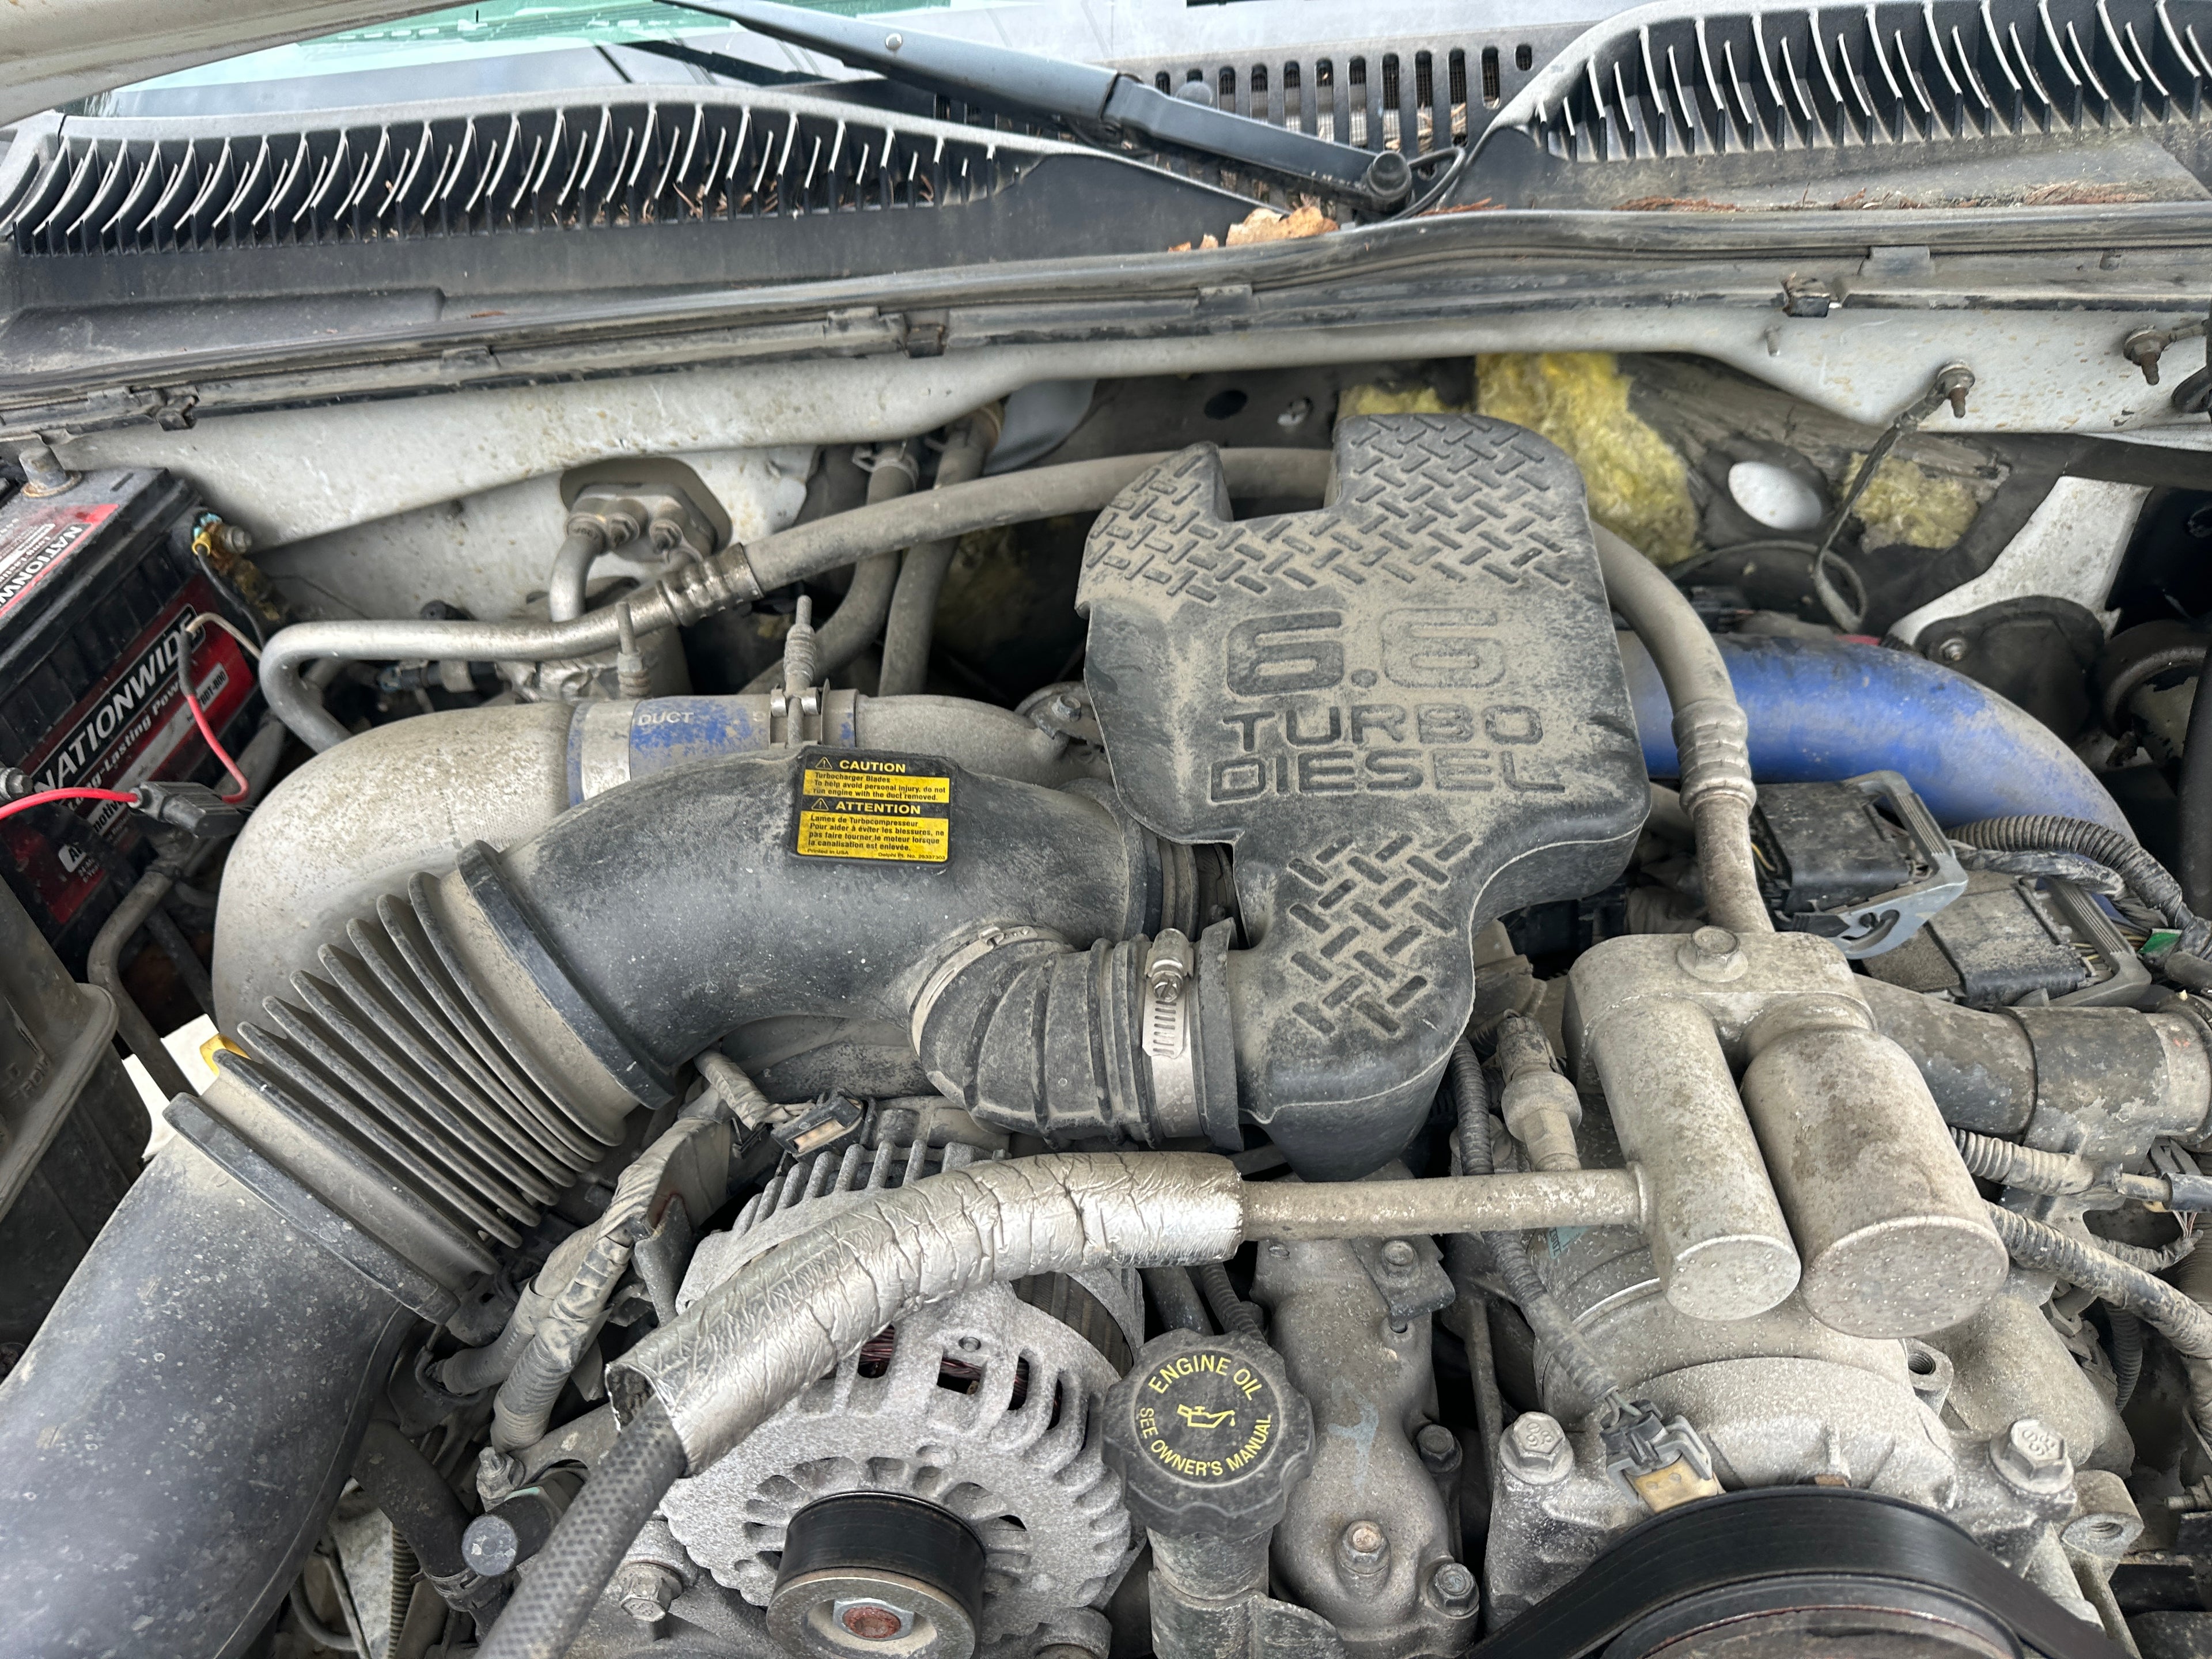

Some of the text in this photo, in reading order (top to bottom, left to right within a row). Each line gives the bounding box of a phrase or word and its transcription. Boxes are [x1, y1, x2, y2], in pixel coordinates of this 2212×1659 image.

[1227, 608, 1506, 695] 6.6
[638, 711, 695, 726] DUCT
[1223, 702, 1543, 751] TURBO
[839, 759, 906, 773] CAUTION
[815, 772, 891, 783] Turbocharger Blades
[1210, 750, 1566, 804] DIESEL
[843, 781, 862, 789] avoid
[865, 782, 896, 792] personal
[828, 789, 853, 797] engine
[904, 792, 938, 801] removed.
[835, 801, 921, 815] ATTENTION
[850, 817, 918, 827] Turbocompresseur
[817, 840, 863, 849] canalisation
[844, 833, 872, 841] tourner
[912, 837, 940, 845] lorsque
[1148, 1354, 1262, 1401] ENGINE OIL
[1139, 1407, 1272, 1476] SEE OWNER'S MANUAL
